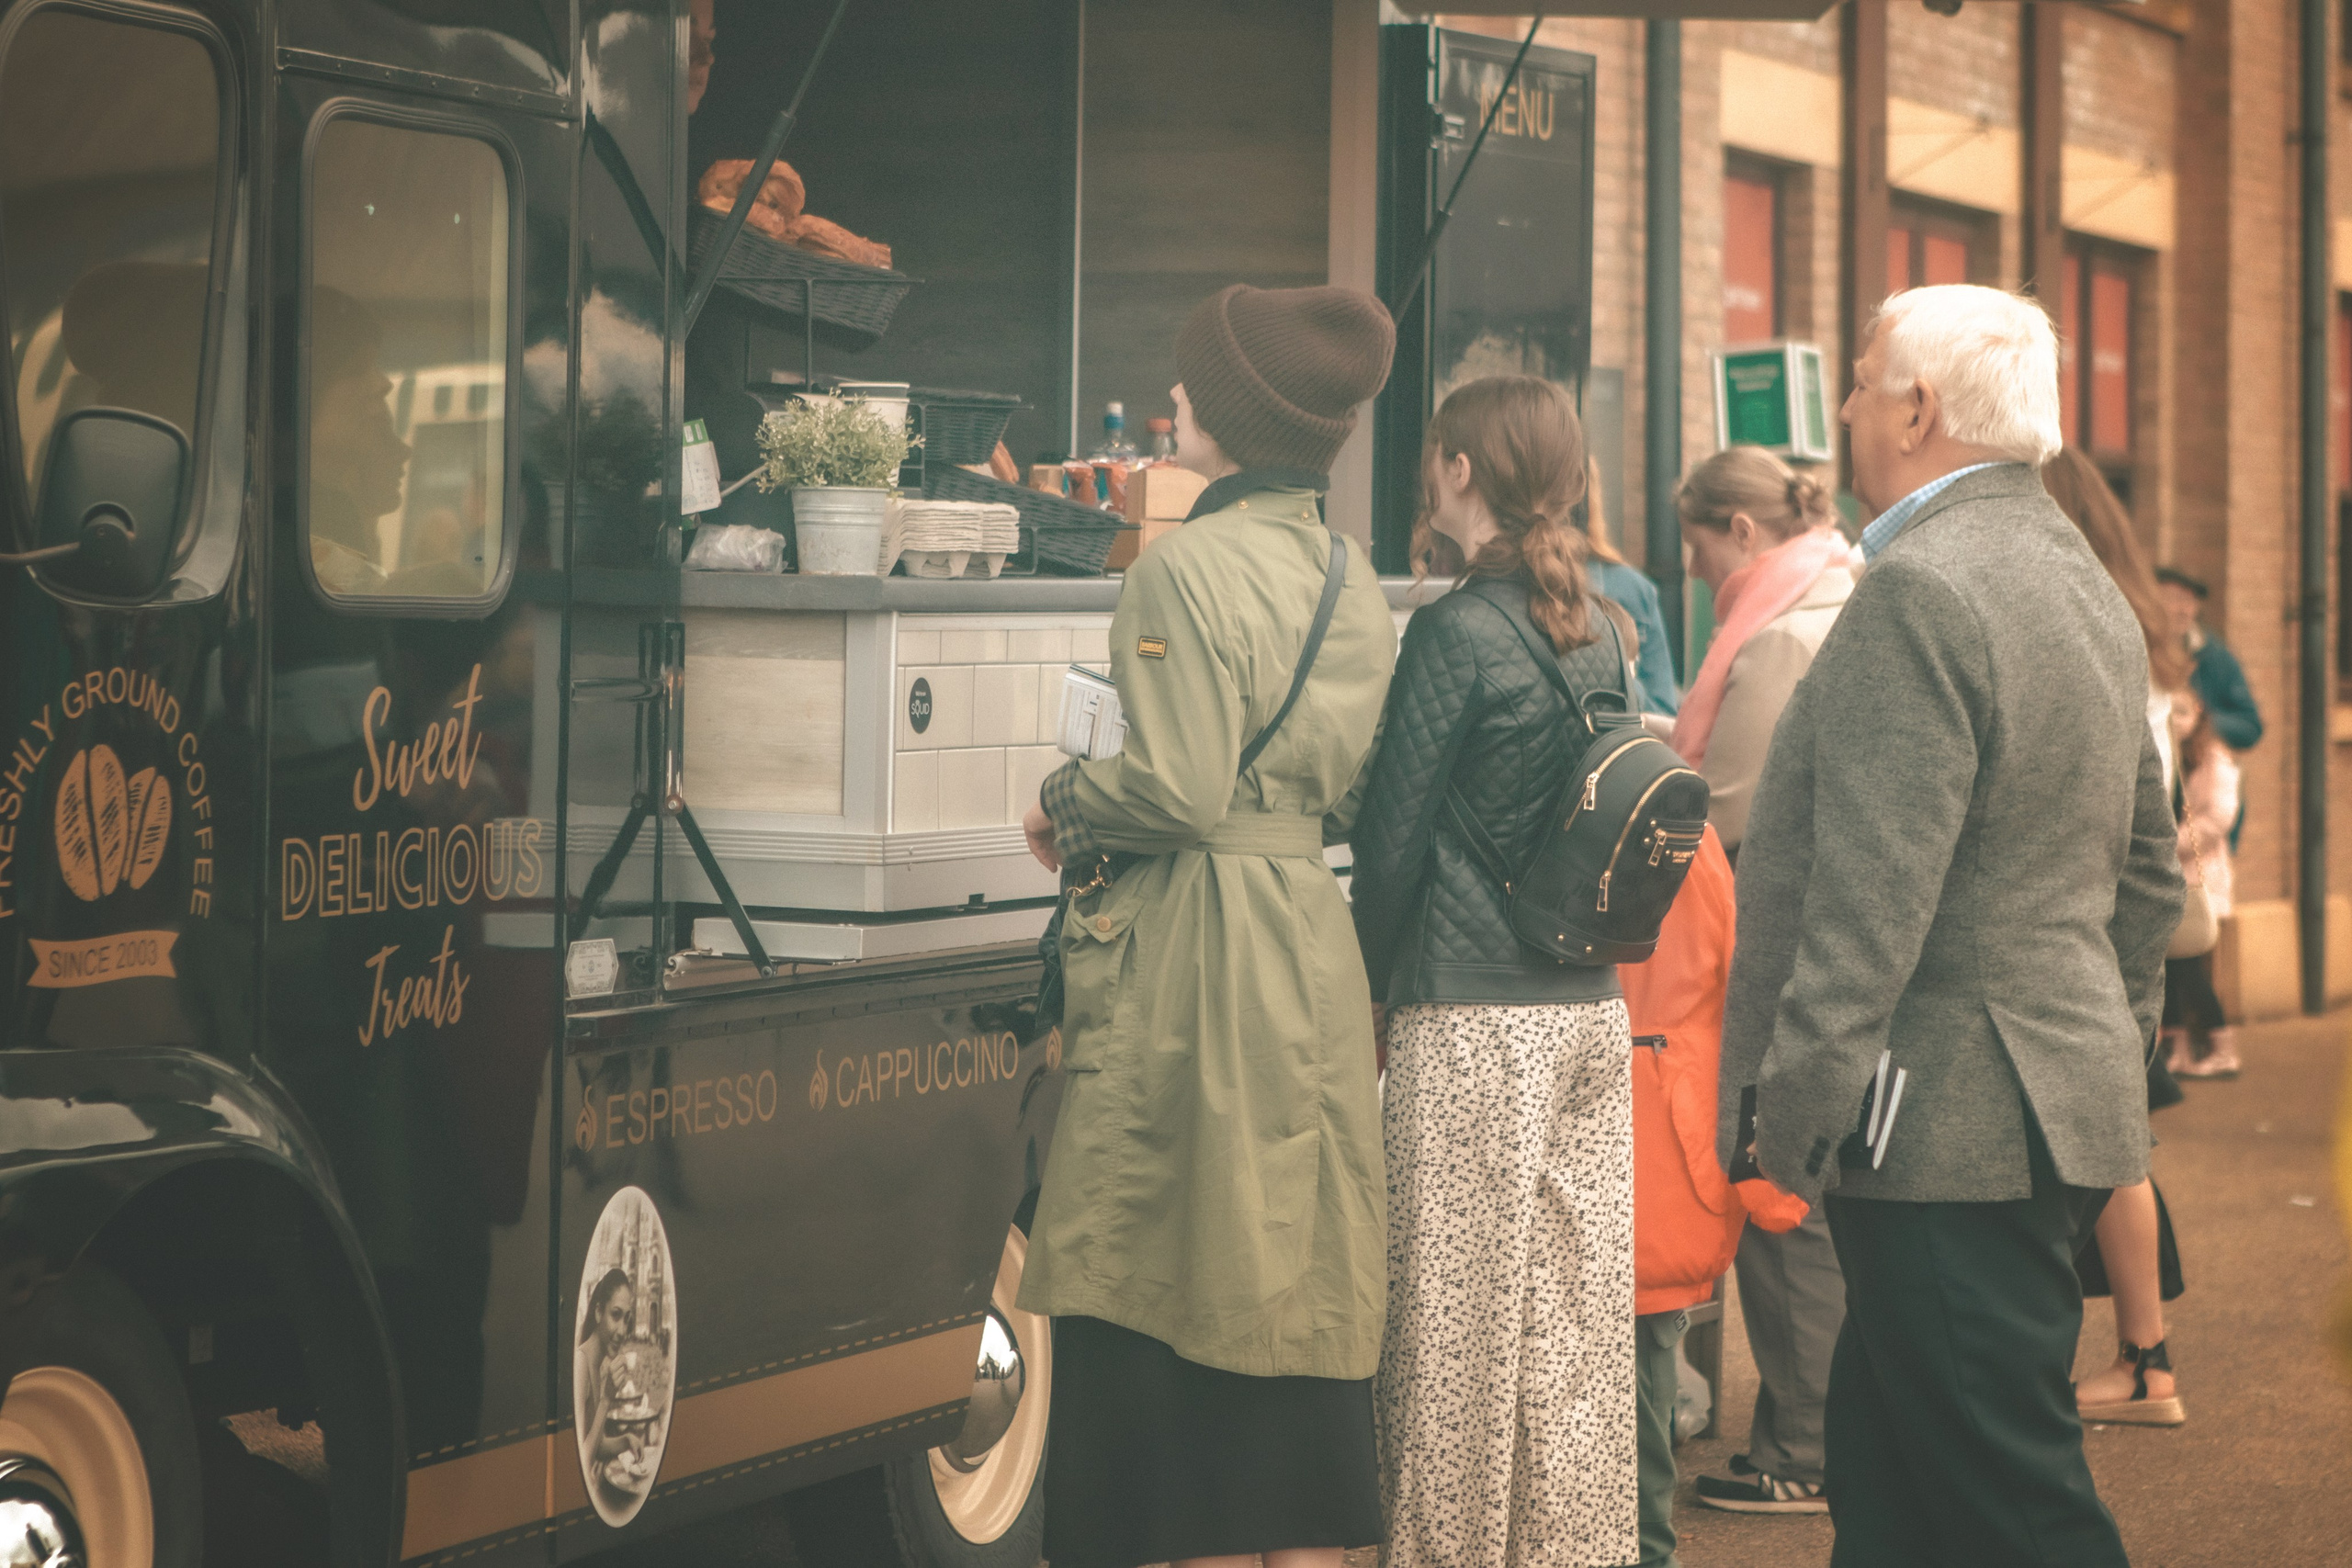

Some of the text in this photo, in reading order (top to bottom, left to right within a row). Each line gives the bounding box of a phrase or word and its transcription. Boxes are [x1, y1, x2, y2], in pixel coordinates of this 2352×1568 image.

[1479, 83, 1554, 141] MENU
[353, 663, 483, 812] Sweet
[910, 699, 930, 719] SQUID
[62, 667, 180, 734] GROUND
[178, 732, 214, 919] COFFEE
[282, 818, 543, 921] DELICIOUS
[49, 939, 158, 978] SINCE 2003
[358, 924, 470, 1047] Treats
[605, 1031, 1019, 1148] ESPRESSO CAPPUCCINO
